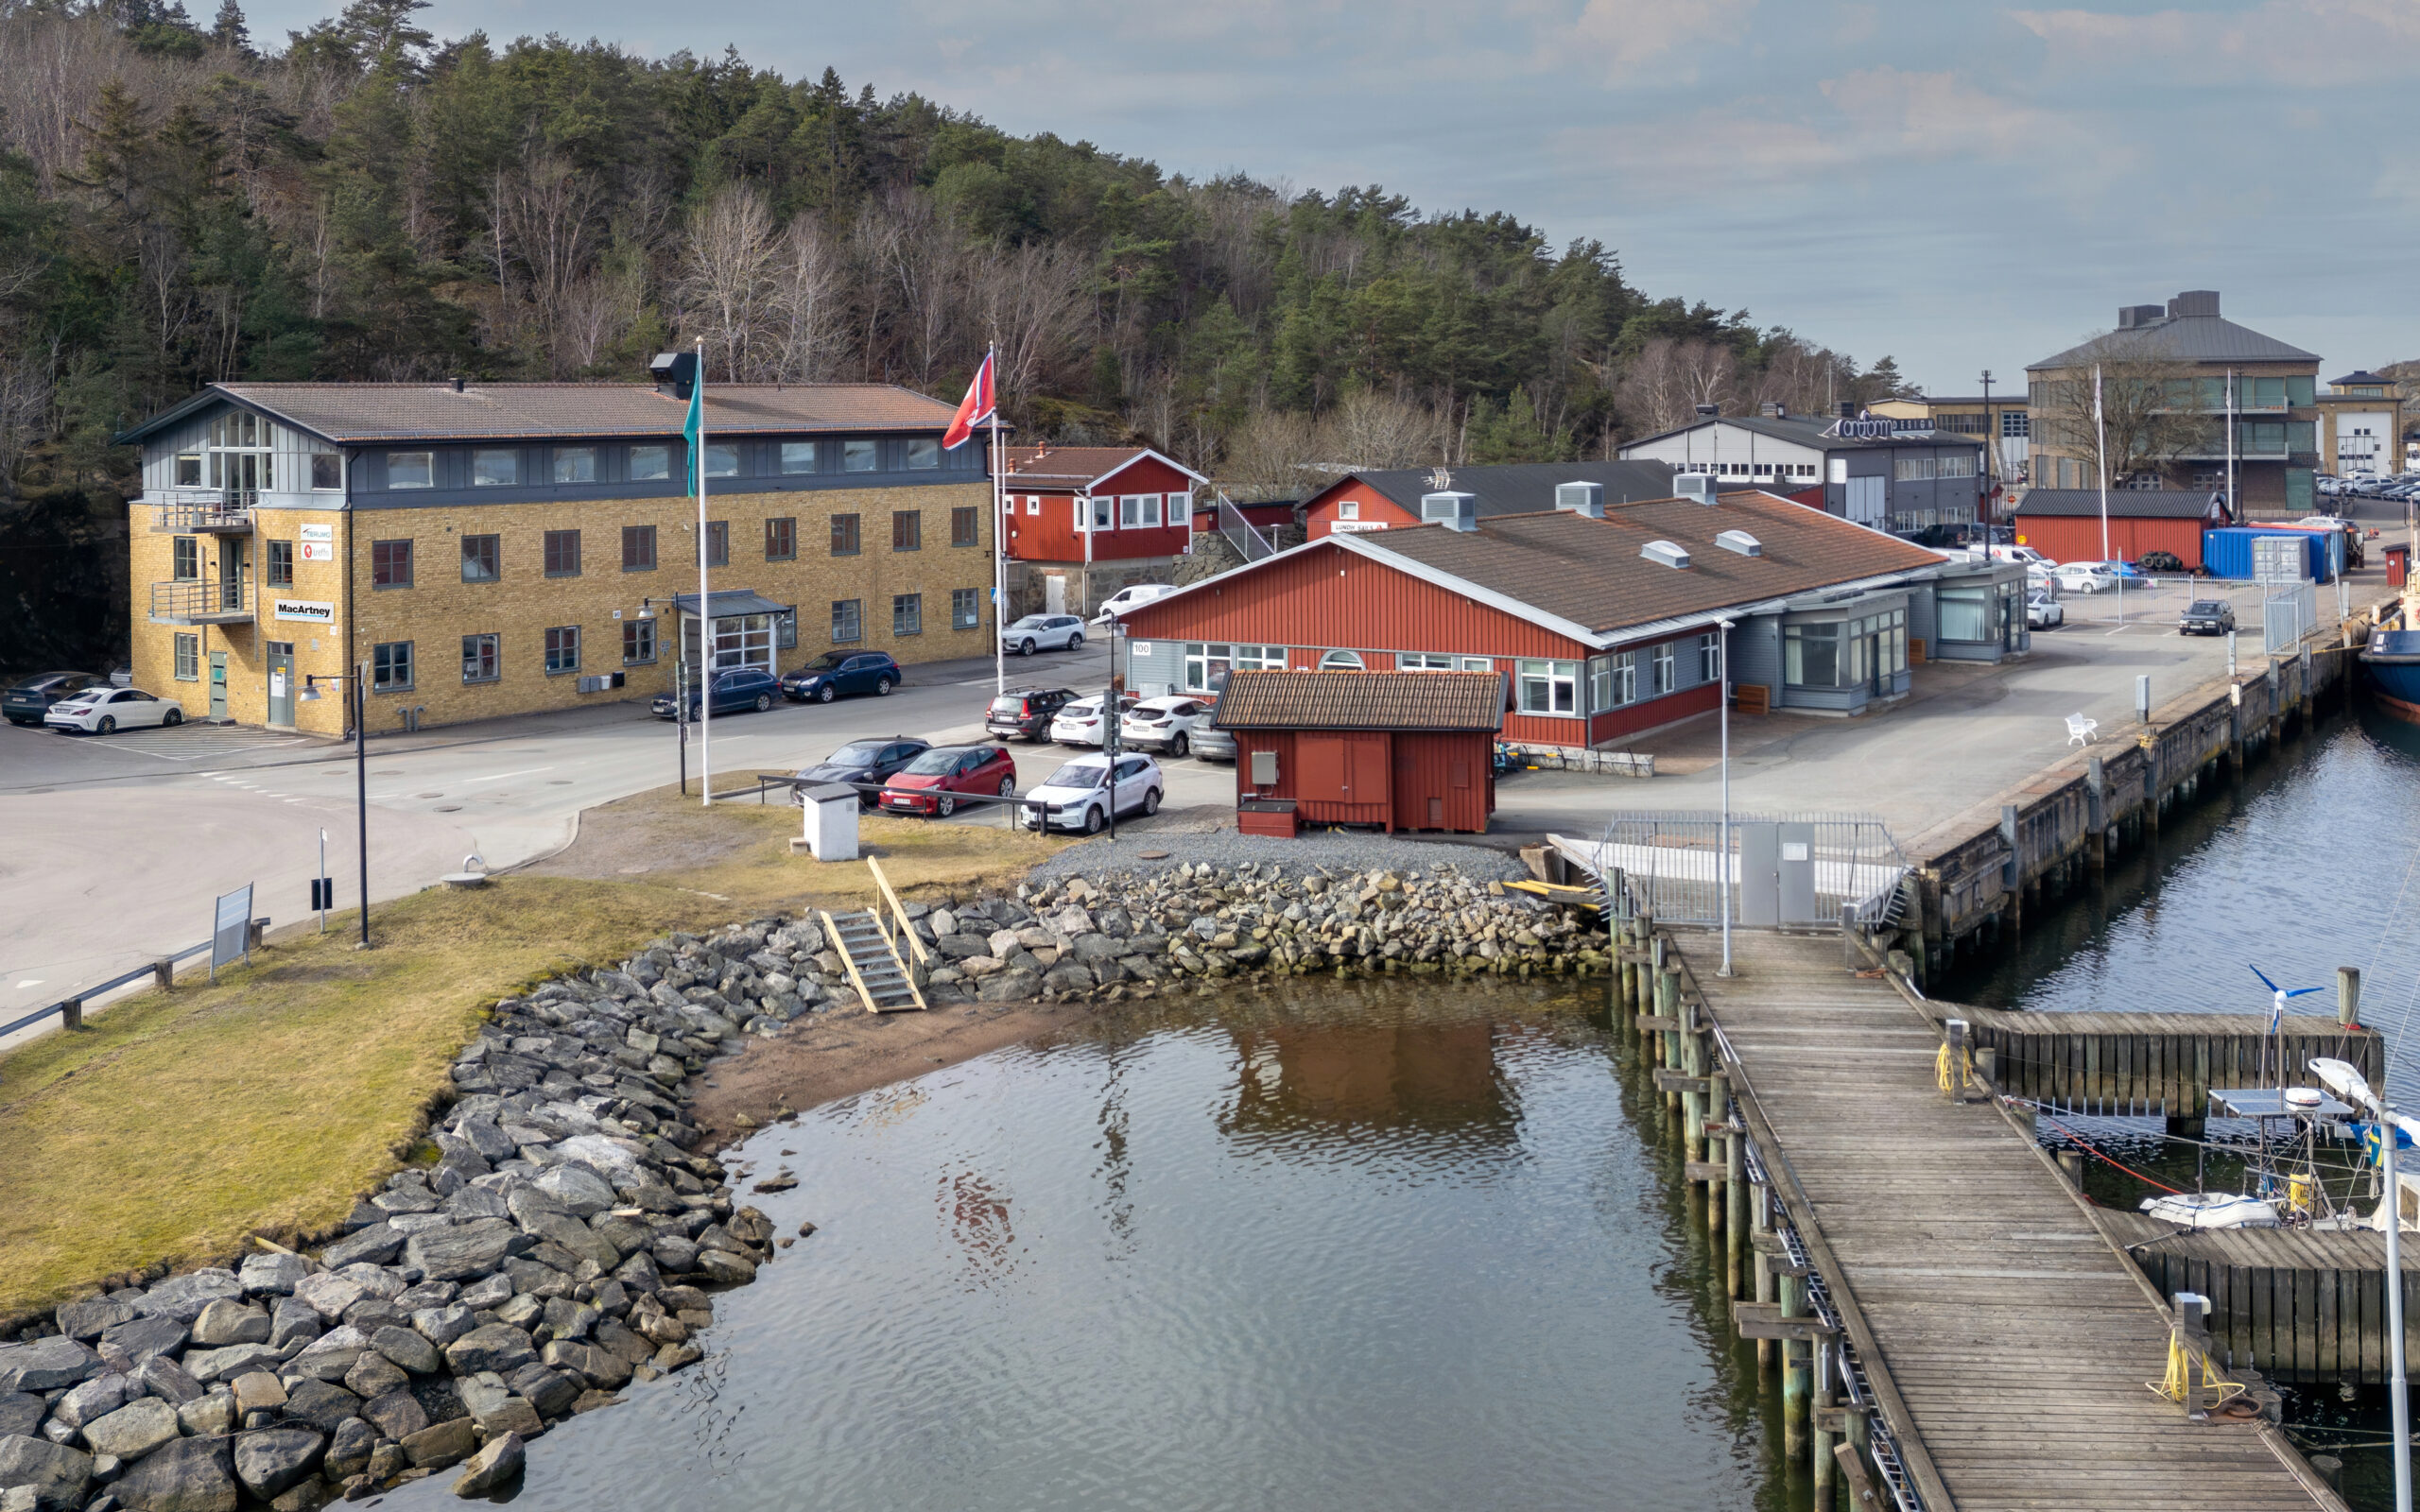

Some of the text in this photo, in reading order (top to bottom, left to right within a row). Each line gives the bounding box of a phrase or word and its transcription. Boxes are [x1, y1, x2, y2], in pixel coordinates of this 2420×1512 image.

[1893, 420, 1933, 430] DESIGN
[278, 604, 330, 617] MacArtney
[1134, 644, 1150, 653] 100
